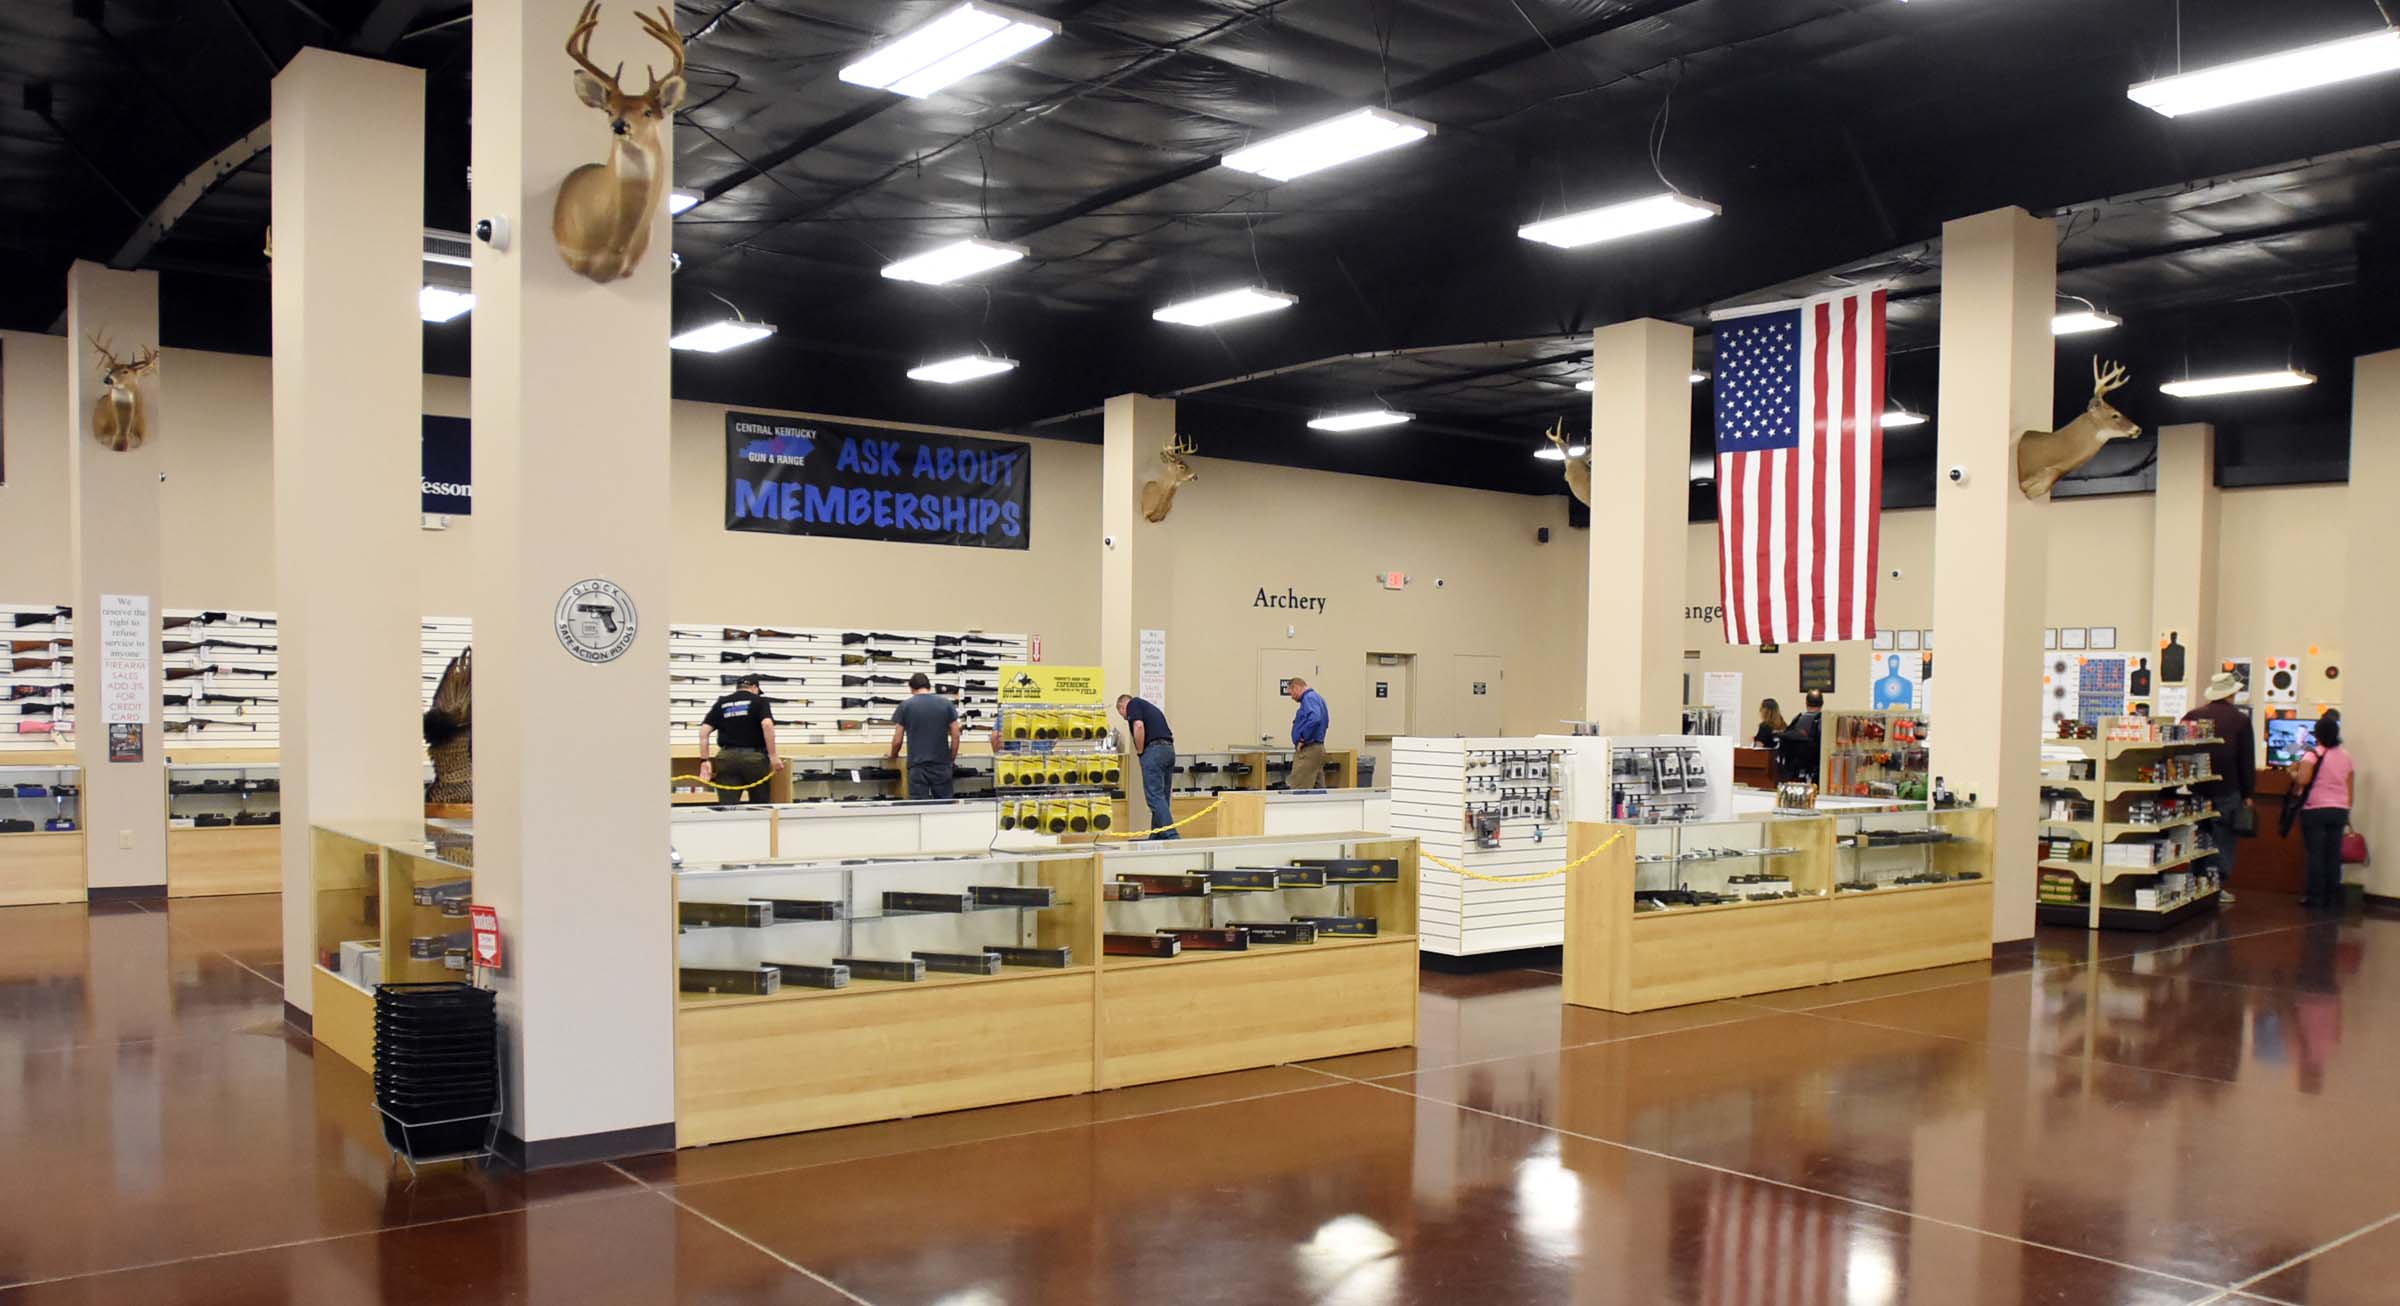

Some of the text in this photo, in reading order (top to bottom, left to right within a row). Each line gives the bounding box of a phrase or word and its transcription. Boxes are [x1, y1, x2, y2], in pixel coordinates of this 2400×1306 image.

[735, 422, 817, 439] CENTRAL KENTUCKY
[748, 451, 805, 466] GUN & RANGE
[836, 436, 1021, 487] ASK ABOUT
[420, 477, 472, 497] esson
[735, 478, 1021, 537] MEMBERSHIPS
[572, 582, 619, 597] GLOCK
[117, 597, 131, 606] We
[1253, 587, 1327, 615] Archery
[1685, 605, 1724, 623] ange
[609, 626, 635, 656] PISTOLS
[105, 661, 146, 669] FIREARM
[111, 672, 138, 680] SALES
[108, 703, 142, 711] CREDIT
[111, 713, 140, 721] CARD
